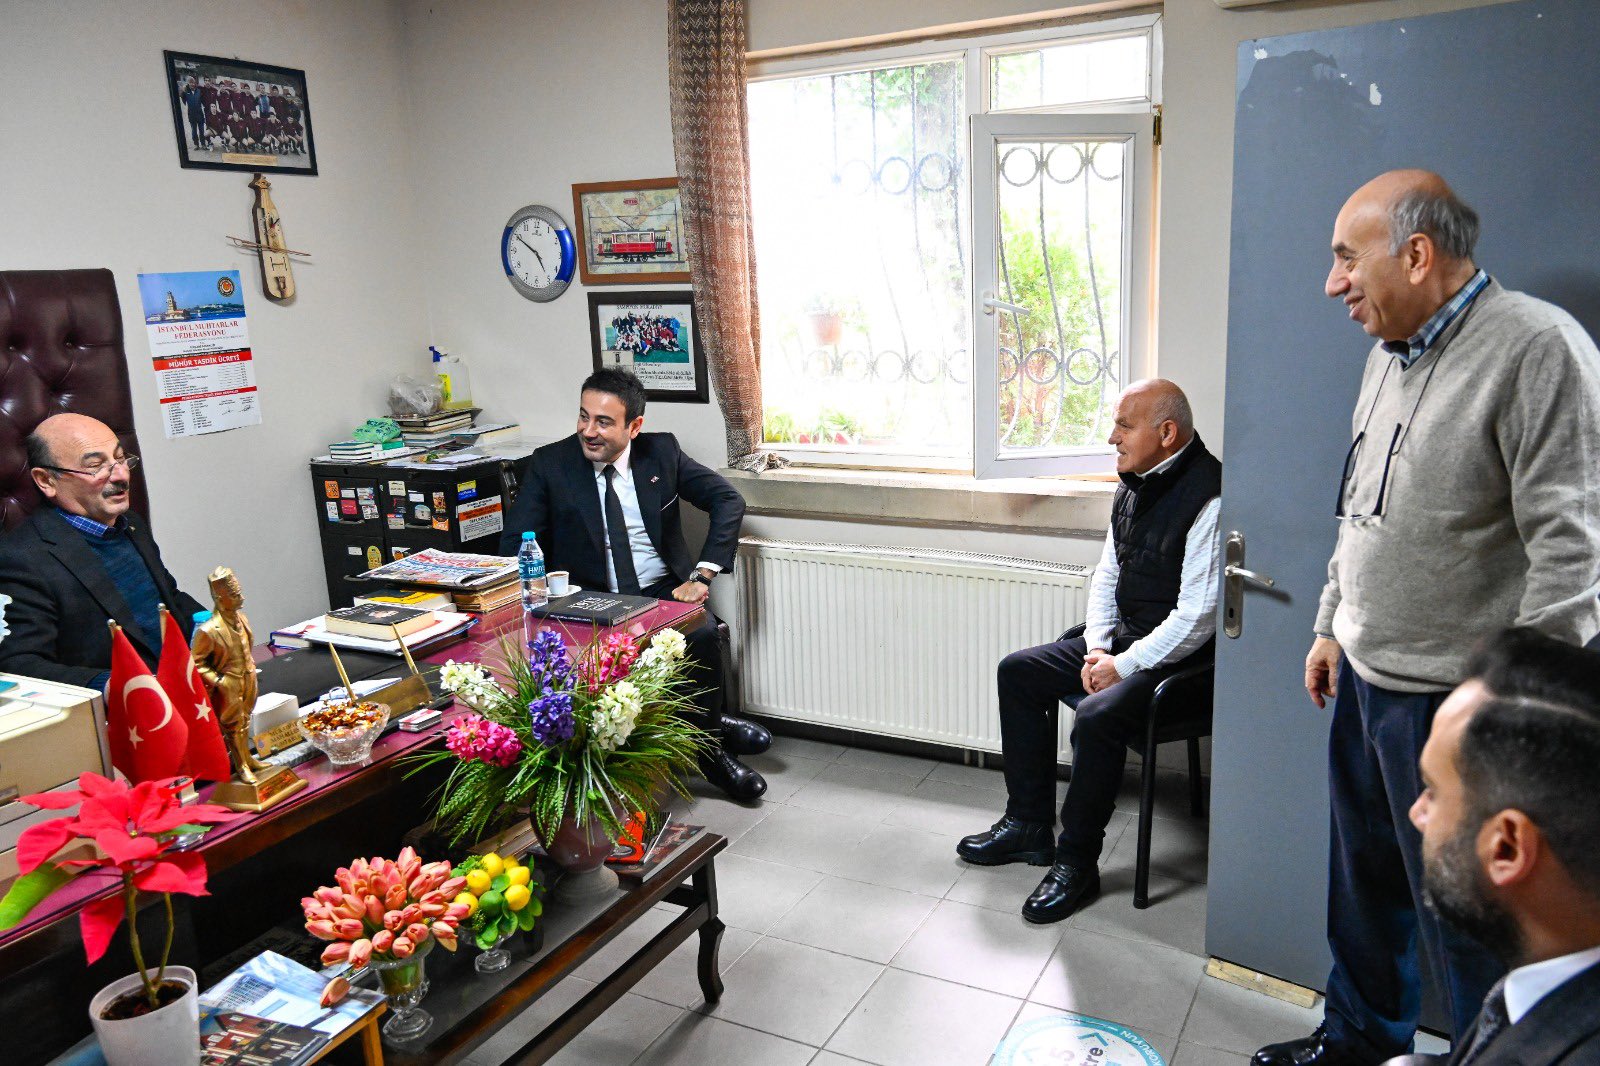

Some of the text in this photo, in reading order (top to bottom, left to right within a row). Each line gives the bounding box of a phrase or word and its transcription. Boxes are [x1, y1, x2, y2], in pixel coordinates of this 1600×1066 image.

[523, 224, 529, 232] 11
[533, 221, 540, 229] 12
[516, 260, 521, 269] 8
[534, 275, 539, 285] 6
[157, 321, 239, 333] İSTANBUL MUHTARLAR
[174, 330, 227, 339] FEDERASYONU
[168, 358, 193, 369] MÜHÜR
[193, 356, 218, 366] TASDİK
[218, 353, 240, 364] ÜCRETİ
[1120, 1030, 1163, 1066] KORUYUN
